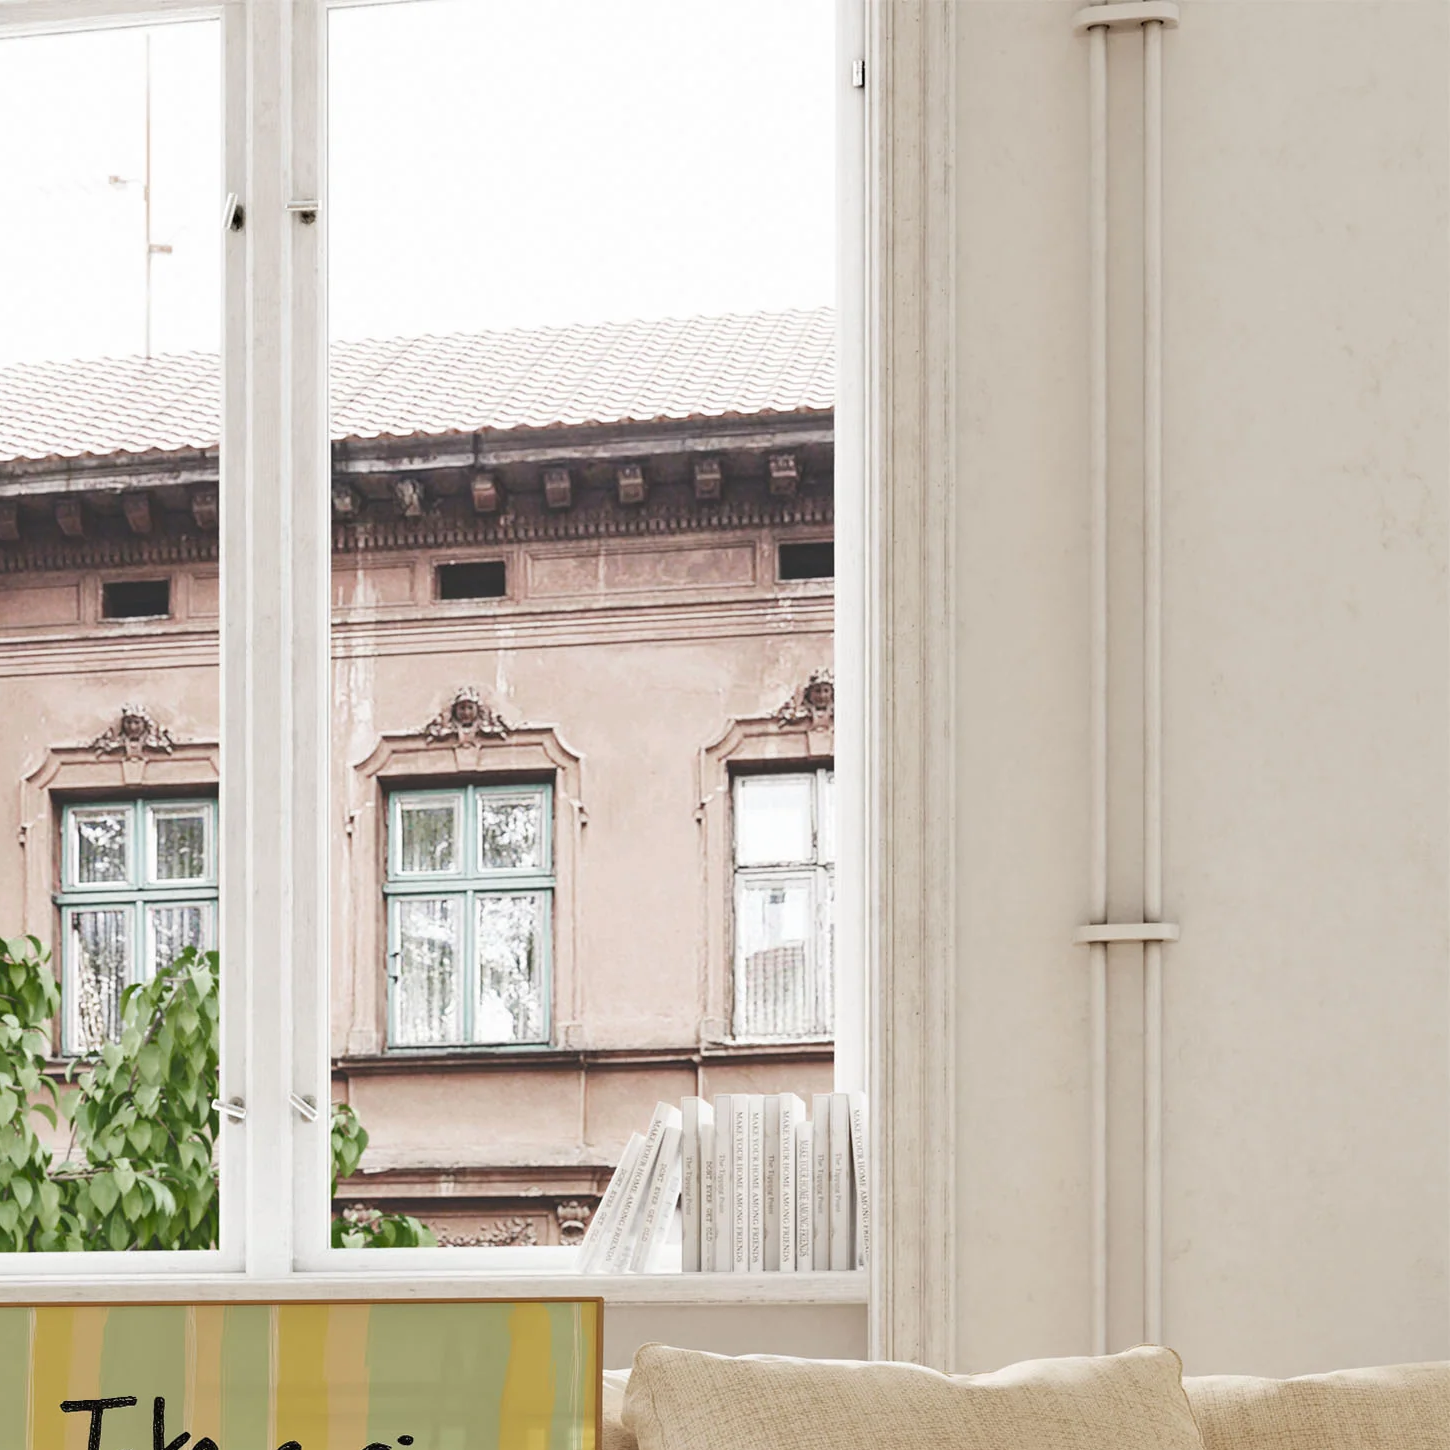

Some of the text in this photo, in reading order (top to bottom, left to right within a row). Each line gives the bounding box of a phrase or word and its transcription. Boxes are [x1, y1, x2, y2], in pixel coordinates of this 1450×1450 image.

[647, 1120, 662, 1144] MAKE
[853, 1110, 861, 1133] MAKE
[639, 1144, 653, 1167] YOUR
[855, 1136, 864, 1159] YOUR
[630, 1168, 644, 1192] HOME
[858, 1161, 867, 1187] HOME
[618, 1196, 634, 1225] AMONG
[605, 1227, 624, 1262] FRIENDS
